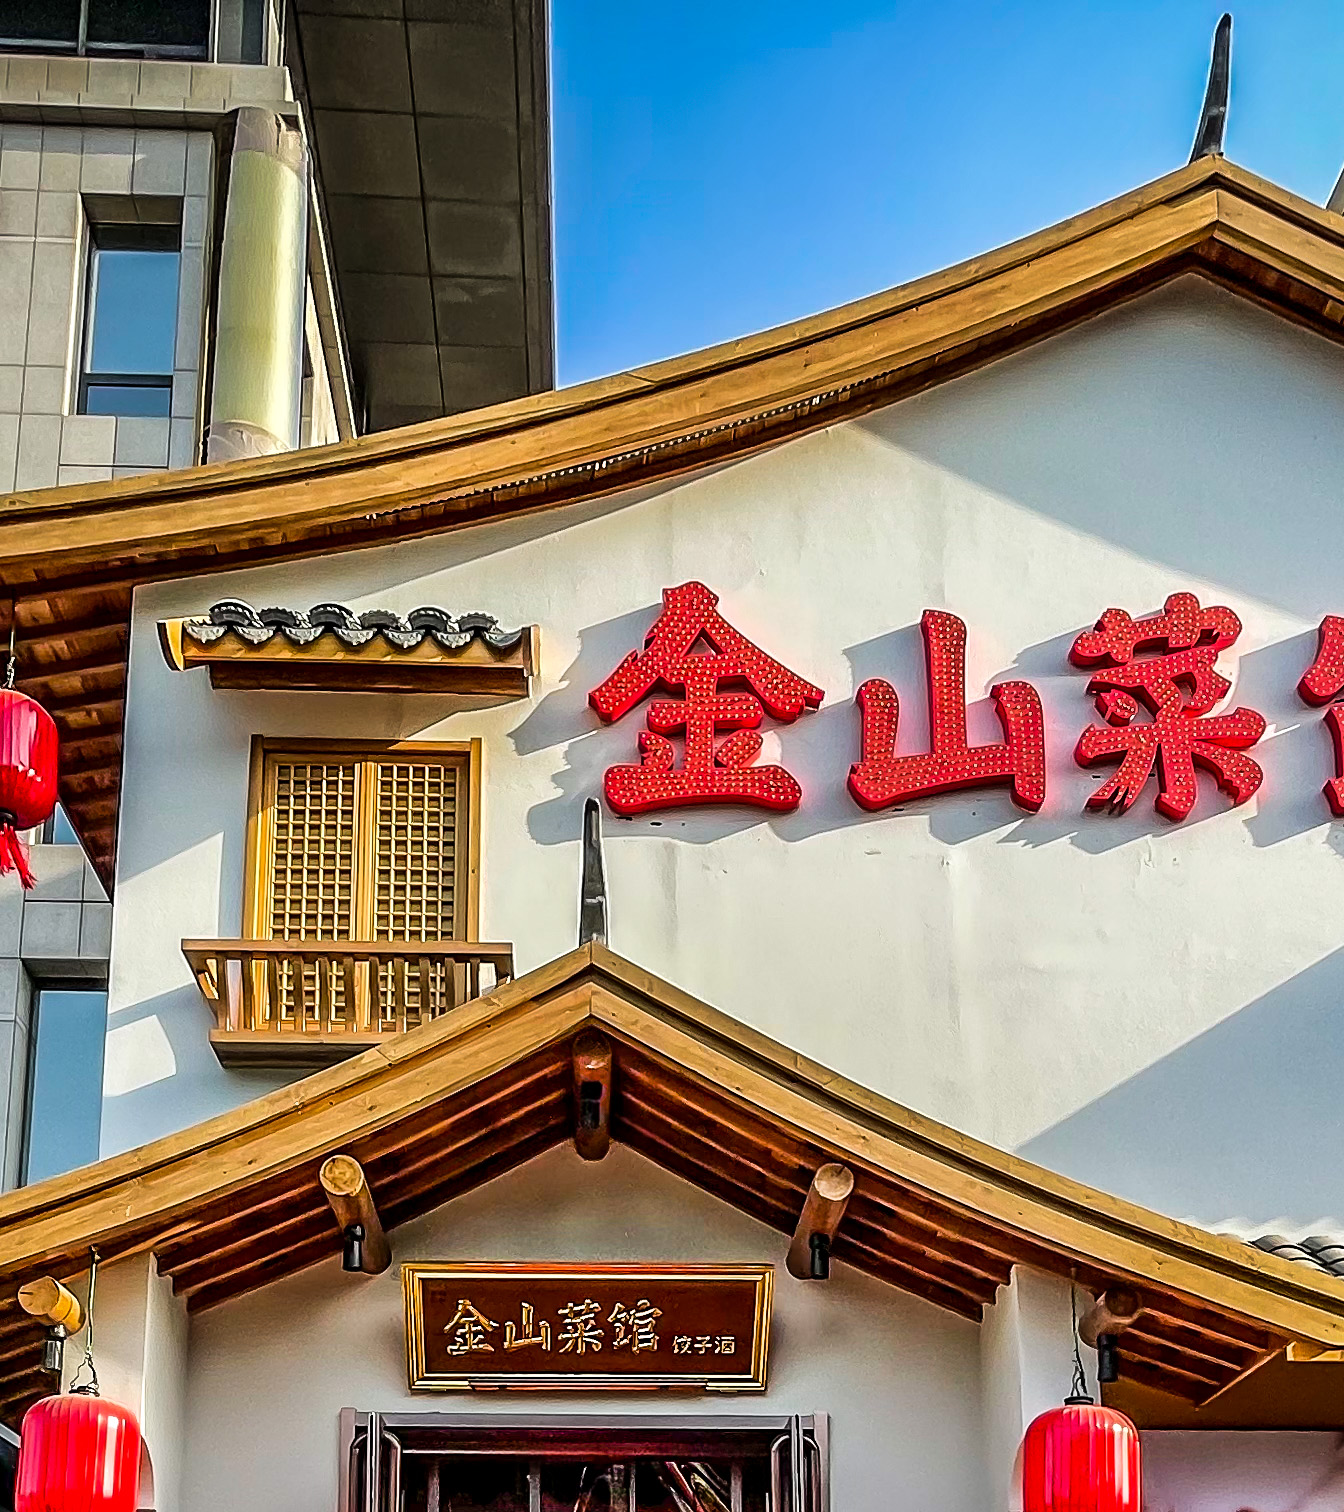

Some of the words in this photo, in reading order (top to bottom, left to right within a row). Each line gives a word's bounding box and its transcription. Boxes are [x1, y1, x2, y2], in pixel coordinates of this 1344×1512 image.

[443, 1298, 663, 1355] 金山菜馆
[672, 1335, 736, 1355] 饺子酒
